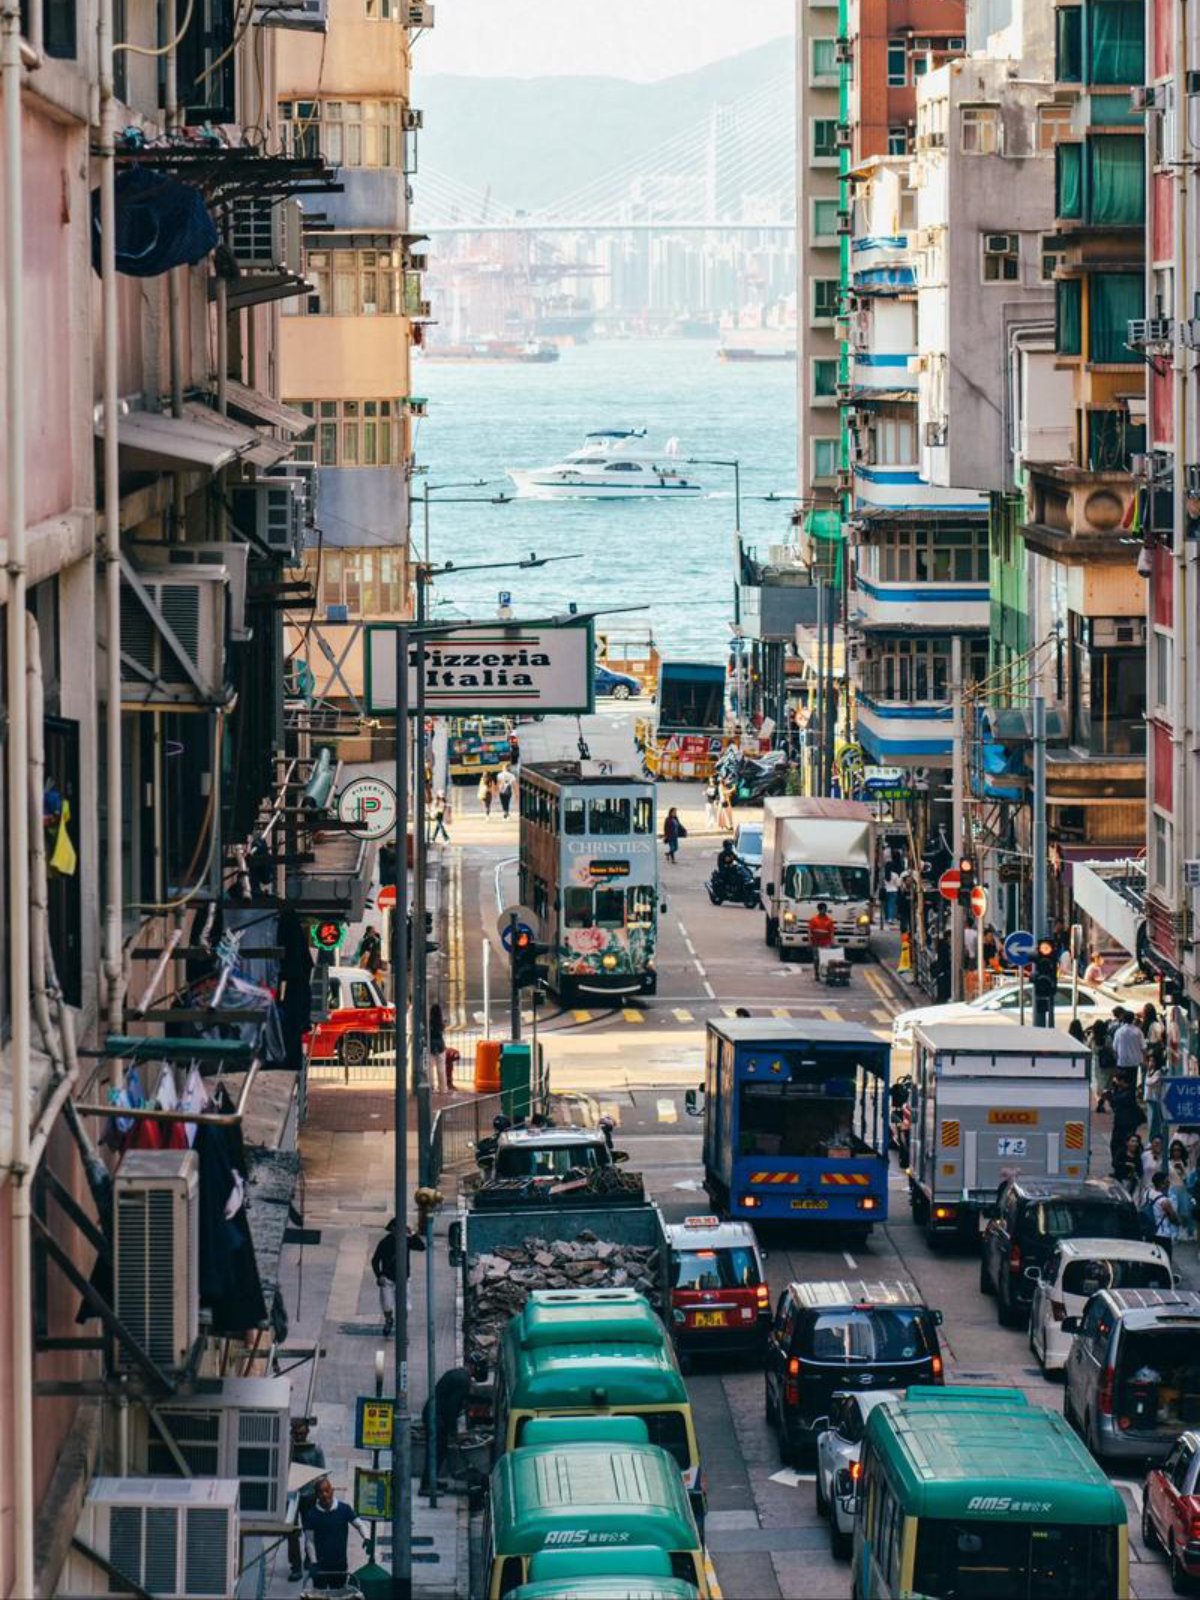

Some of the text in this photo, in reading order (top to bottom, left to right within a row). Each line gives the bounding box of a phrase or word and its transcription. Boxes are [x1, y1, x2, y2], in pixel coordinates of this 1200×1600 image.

[500, 592, 509, 604] P
[408, 650, 551, 667] Pizzeria
[426, 669, 533, 687] Italia
[1176, 1102, 1200, 1117] 域
[967, 1496, 1012, 1510] AMS
[544, 1529, 589, 1544] AMS
